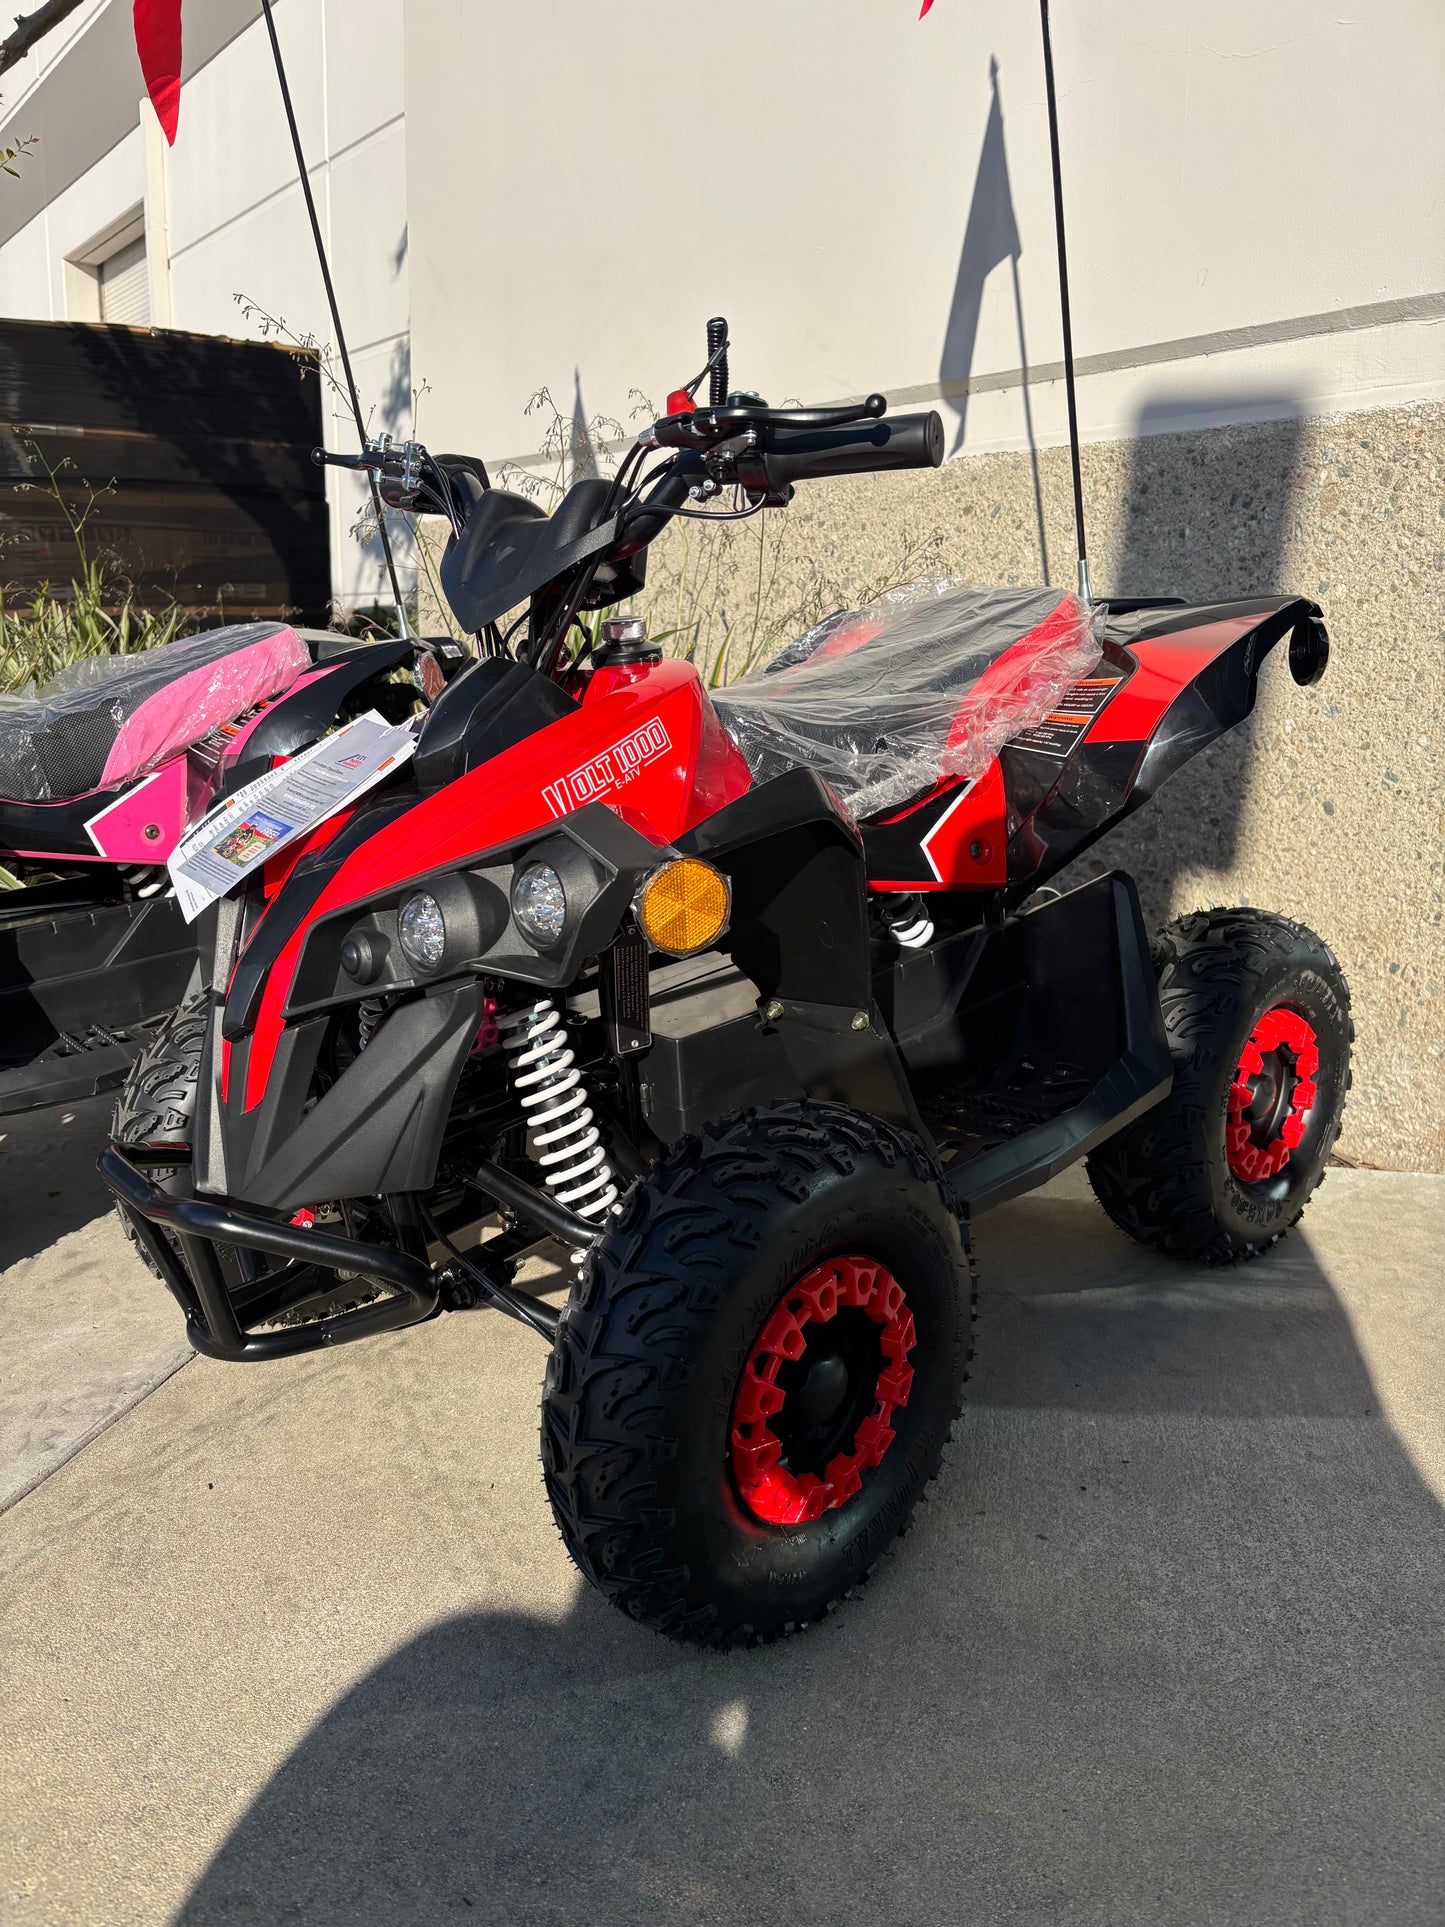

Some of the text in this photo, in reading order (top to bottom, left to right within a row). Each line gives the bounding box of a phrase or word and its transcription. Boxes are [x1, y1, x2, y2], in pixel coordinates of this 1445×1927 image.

[541, 722, 667, 818] VOLT 1000
[614, 766, 642, 790] E-ATV
